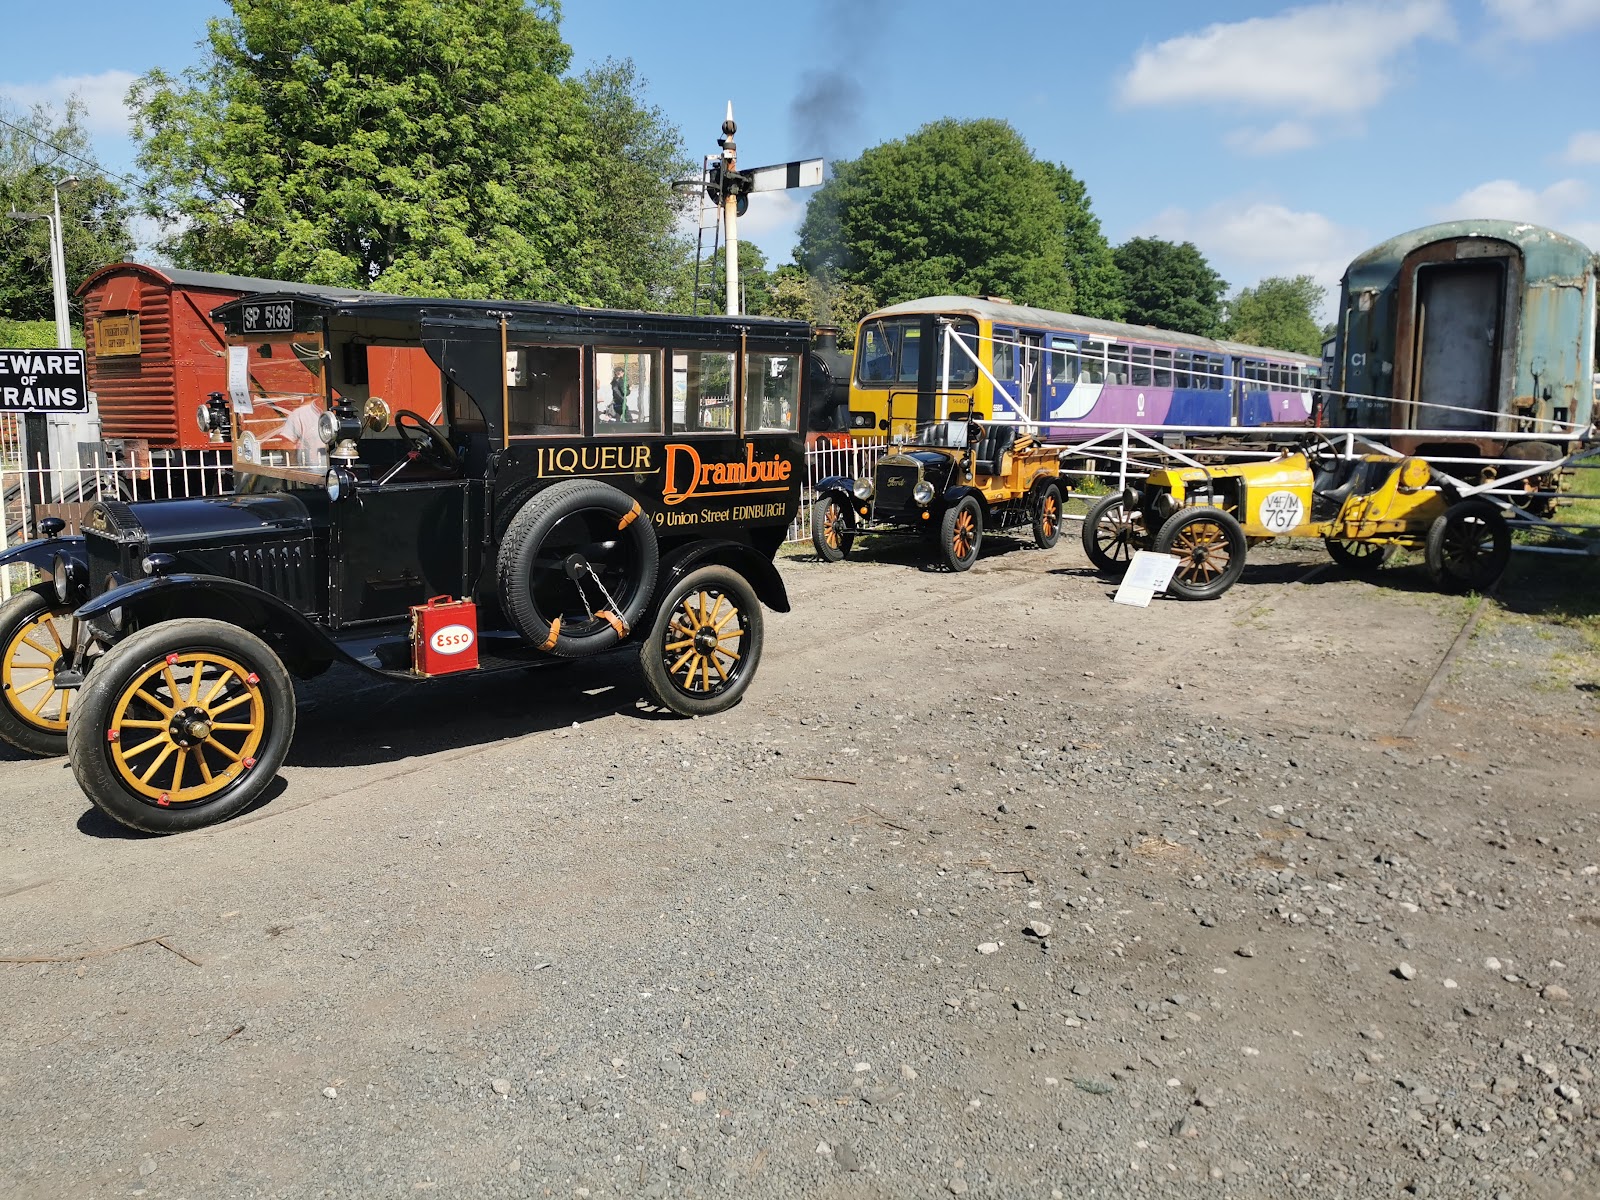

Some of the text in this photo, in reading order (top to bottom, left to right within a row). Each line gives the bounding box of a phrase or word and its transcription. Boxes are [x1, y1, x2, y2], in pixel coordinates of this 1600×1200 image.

[245, 305, 291, 329] SP 5139
[0, 355, 80, 374] EWARE
[1351, 353, 1366, 366] C1
[21, 376, 37, 386] OF
[0, 387, 77, 406] RAINS
[537, 445, 652, 478] LIQUEUR
[662, 443, 792, 505] Drambuie
[887, 476, 905, 488] Ford
[645, 502, 786, 527] /9 Union Street EDINBURGH
[1265, 509, 1298, 527] 767
